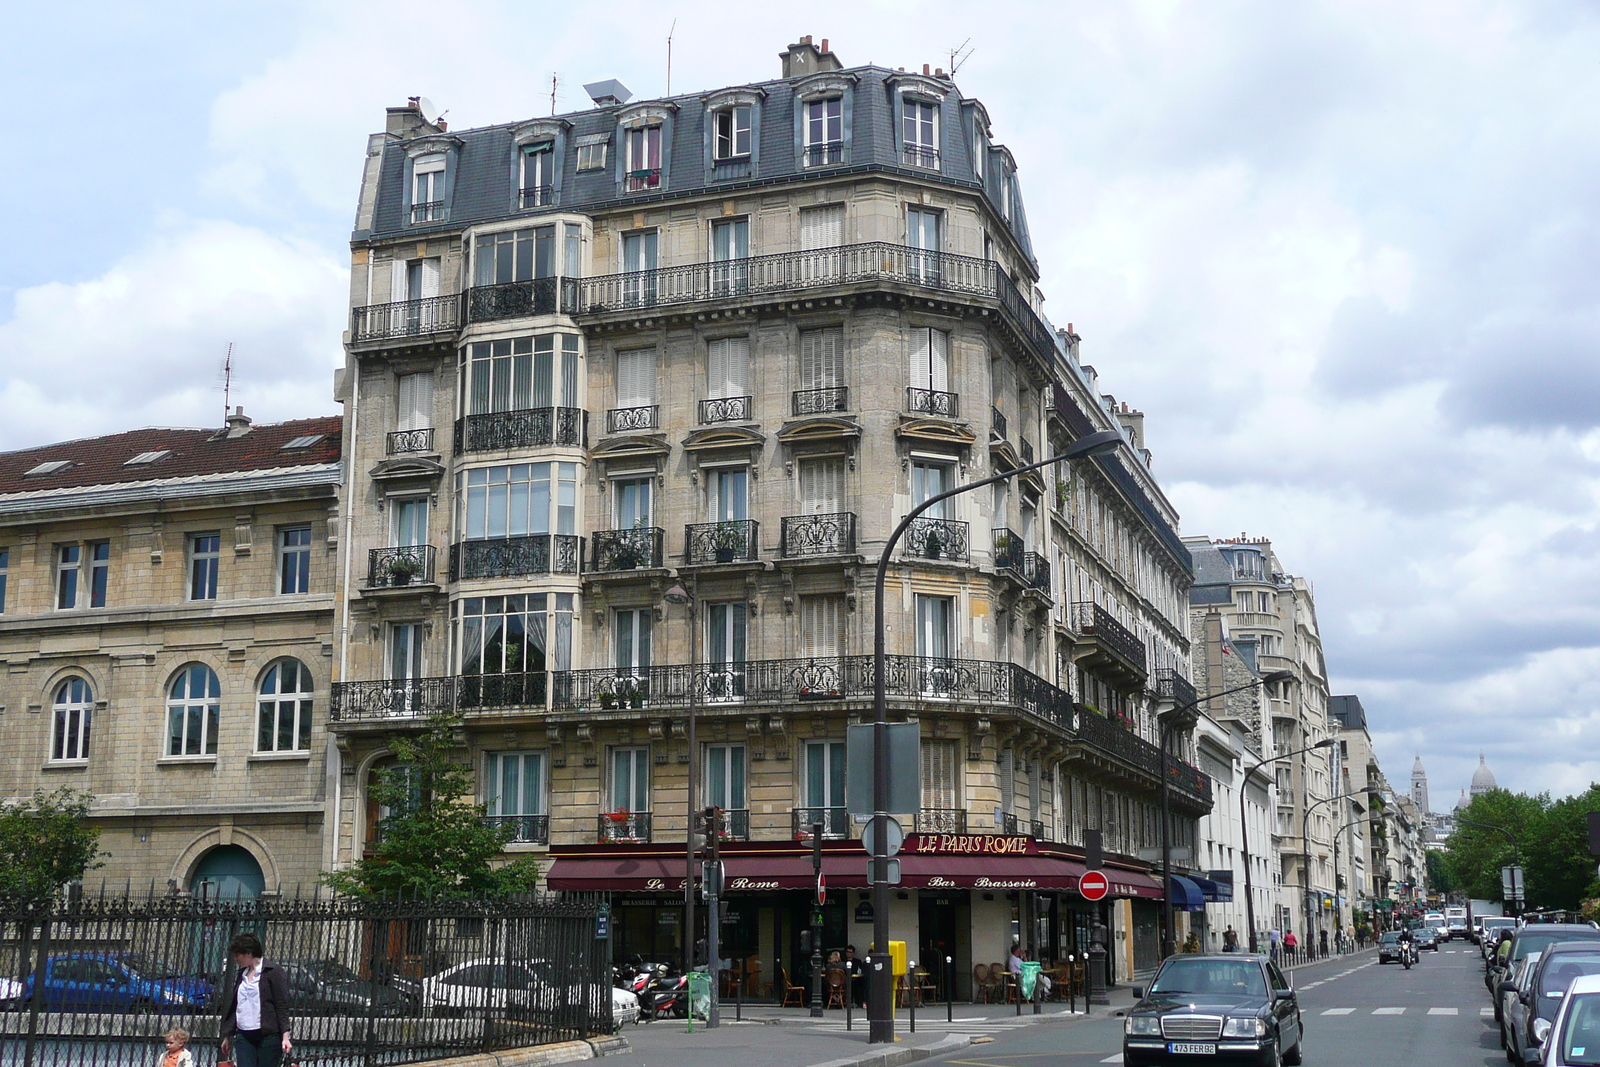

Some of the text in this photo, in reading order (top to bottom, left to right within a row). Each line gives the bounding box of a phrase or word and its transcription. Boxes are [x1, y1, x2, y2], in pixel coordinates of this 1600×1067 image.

[917, 834, 1027, 853] LE PARIS ROME
[645, 878, 665, 890] Le
[731, 877, 779, 889] Rome
[928, 877, 1037, 888] Bar Brasserie
